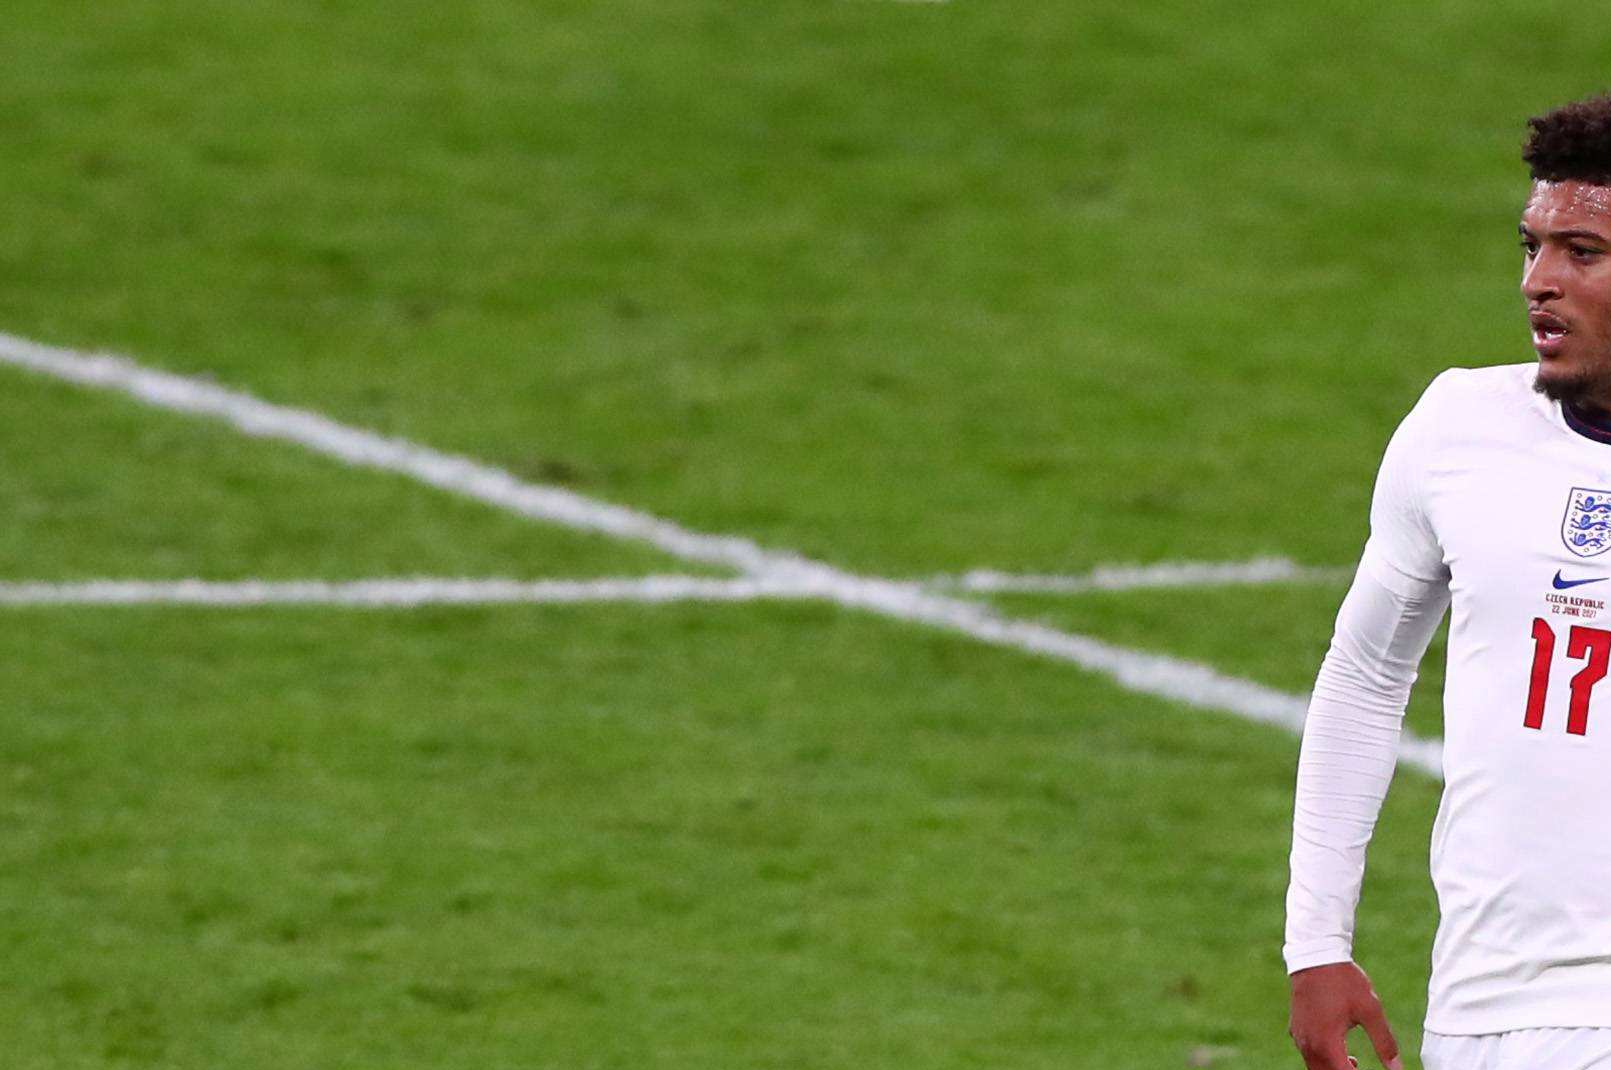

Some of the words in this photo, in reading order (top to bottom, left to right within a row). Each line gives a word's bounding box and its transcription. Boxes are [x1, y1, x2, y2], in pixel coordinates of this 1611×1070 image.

[1545, 593, 1568, 604] CZECH
[1570, 596, 1604, 609] REPUBLIC
[1552, 604, 1560, 614] 22
[1562, 606, 1580, 616] JUNE
